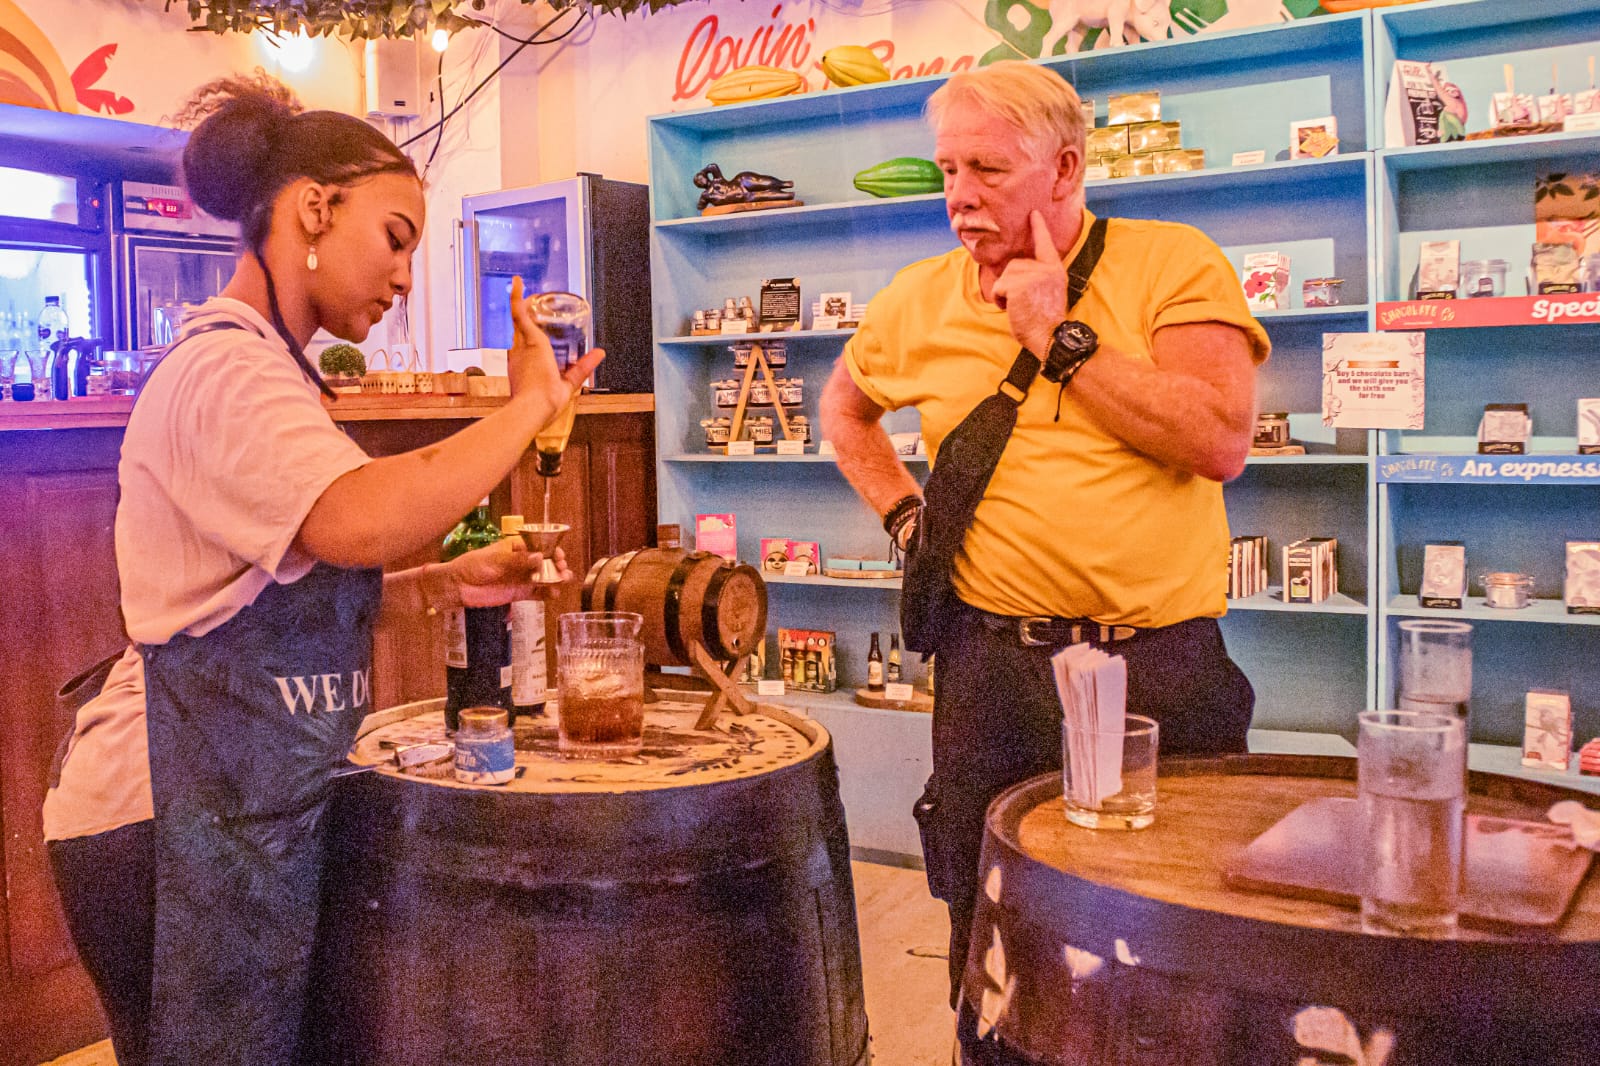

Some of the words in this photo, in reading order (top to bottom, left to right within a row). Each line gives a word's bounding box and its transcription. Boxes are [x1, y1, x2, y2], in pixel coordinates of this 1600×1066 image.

[1381, 304, 1438, 325] CHOCOLATE
[1461, 459, 1497, 477] An
[274, 673, 346, 716] WE
